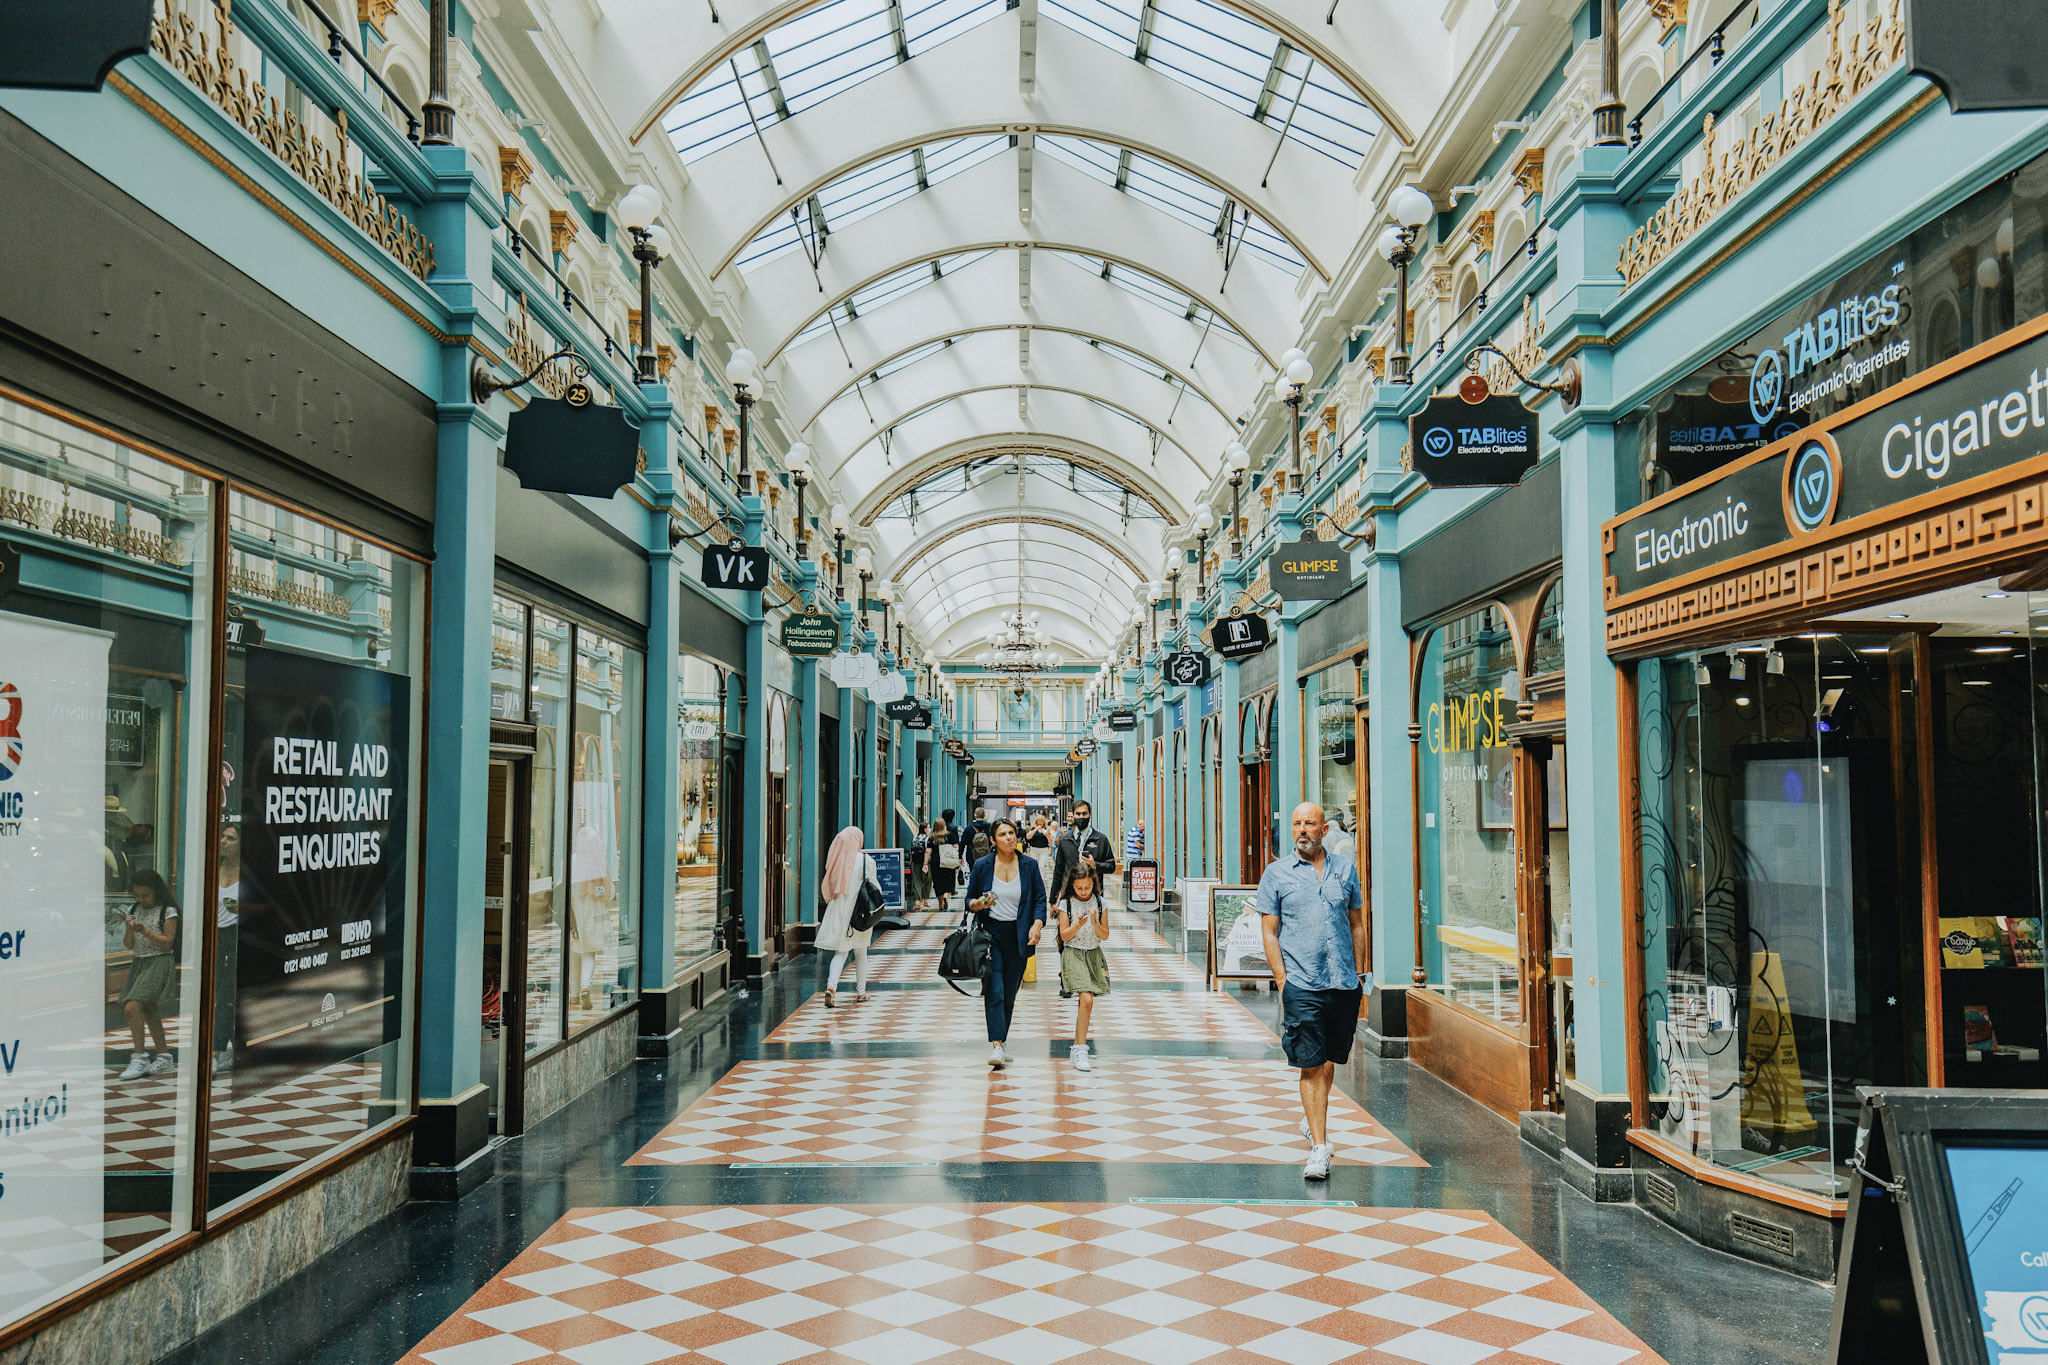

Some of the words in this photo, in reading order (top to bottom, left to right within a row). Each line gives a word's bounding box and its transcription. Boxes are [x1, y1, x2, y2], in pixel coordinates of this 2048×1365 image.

[1789, 371, 1843, 414] Electronic
[1843, 339, 1911, 386] Cigarettes
[570, 388, 586, 401] 25
[1458, 446, 1491, 455] Electronic
[1492, 445, 1527, 455] Cigarettes
[1635, 496, 1749, 573] Electronic
[1282, 560, 1339, 573] GLIMPSE
[800, 618, 821, 626] John
[785, 627, 835, 636] Hollingsworth
[787, 640, 832, 648] Tobacconists
[1428, 687, 1508, 754] GLIMPSE
[273, 736, 343, 776] RETAIL
[348, 742, 389, 778] AND
[1443, 764, 1488, 781] OPTICIANS
[265, 786, 393, 824] RESTAURANT
[278, 830, 381, 874] ENQUIRIES
[1132, 870, 1154, 879] Gym
[284, 929, 311, 946] CREATIVE
[311, 927, 329, 941] RETAIL
[284, 958, 298, 974] 0121
[299, 955, 312, 970] 400
[313, 952, 328, 967] 0407
[312, 1015, 325, 1028] GREAT
